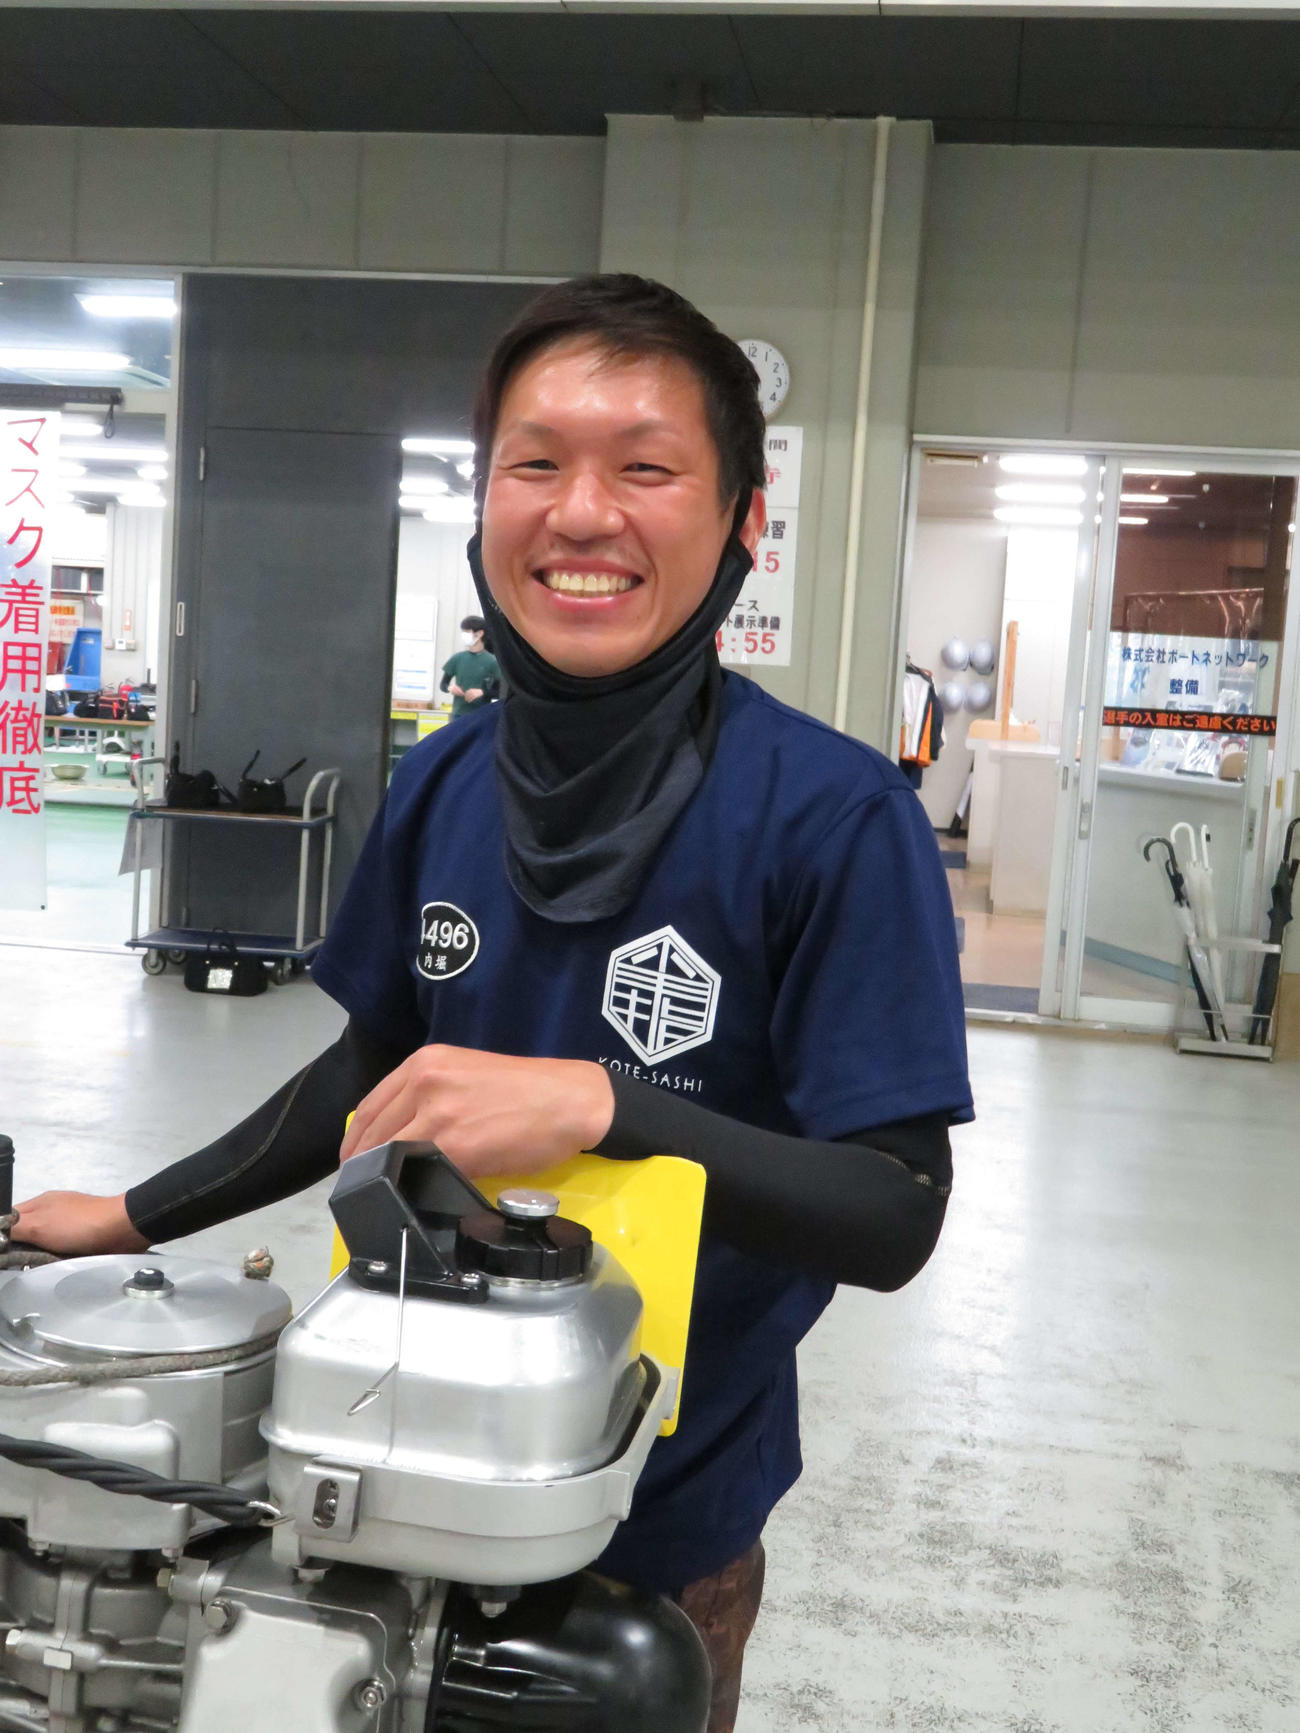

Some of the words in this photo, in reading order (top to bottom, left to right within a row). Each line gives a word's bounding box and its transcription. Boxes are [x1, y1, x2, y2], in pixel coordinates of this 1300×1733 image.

[748, 345, 758, 358] 12
[773, 362, 780, 374] 2
[775, 376, 783, 388] 3
[769, 391, 777, 403] 4
[0, 417, 47, 815] マスク着用徹底
[1121, 646, 1270, 669] 株式会社ボートネットワーク
[1169, 678, 1200, 696] 整備
[1103, 709, 1276, 732] 選手の入室はご遠慮ください
